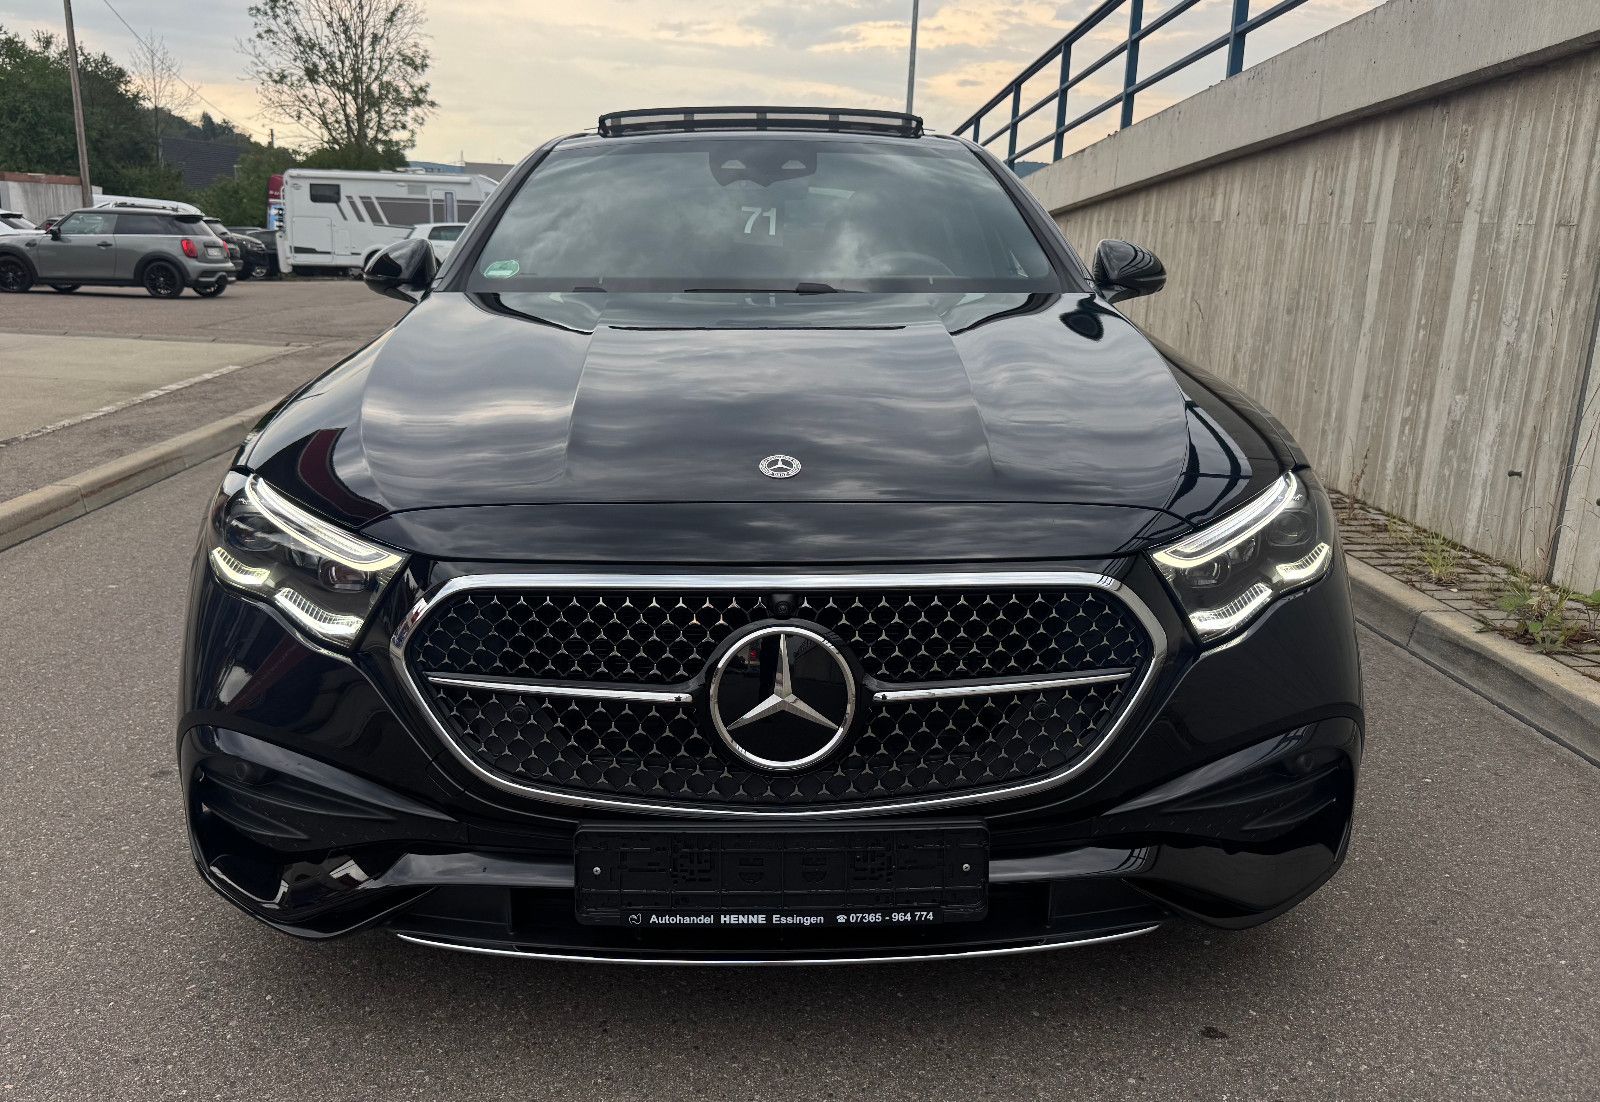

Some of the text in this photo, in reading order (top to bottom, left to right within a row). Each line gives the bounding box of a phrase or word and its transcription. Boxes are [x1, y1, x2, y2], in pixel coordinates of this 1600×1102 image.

[741, 206, 777, 236] 71
[649, 914, 714, 924] Autohandel
[720, 914, 767, 924] HENNE
[772, 914, 824, 926] Essingen
[849, 912, 882, 923] 07365
[891, 911, 912, 922] 964
[914, 911, 934, 921] 774
